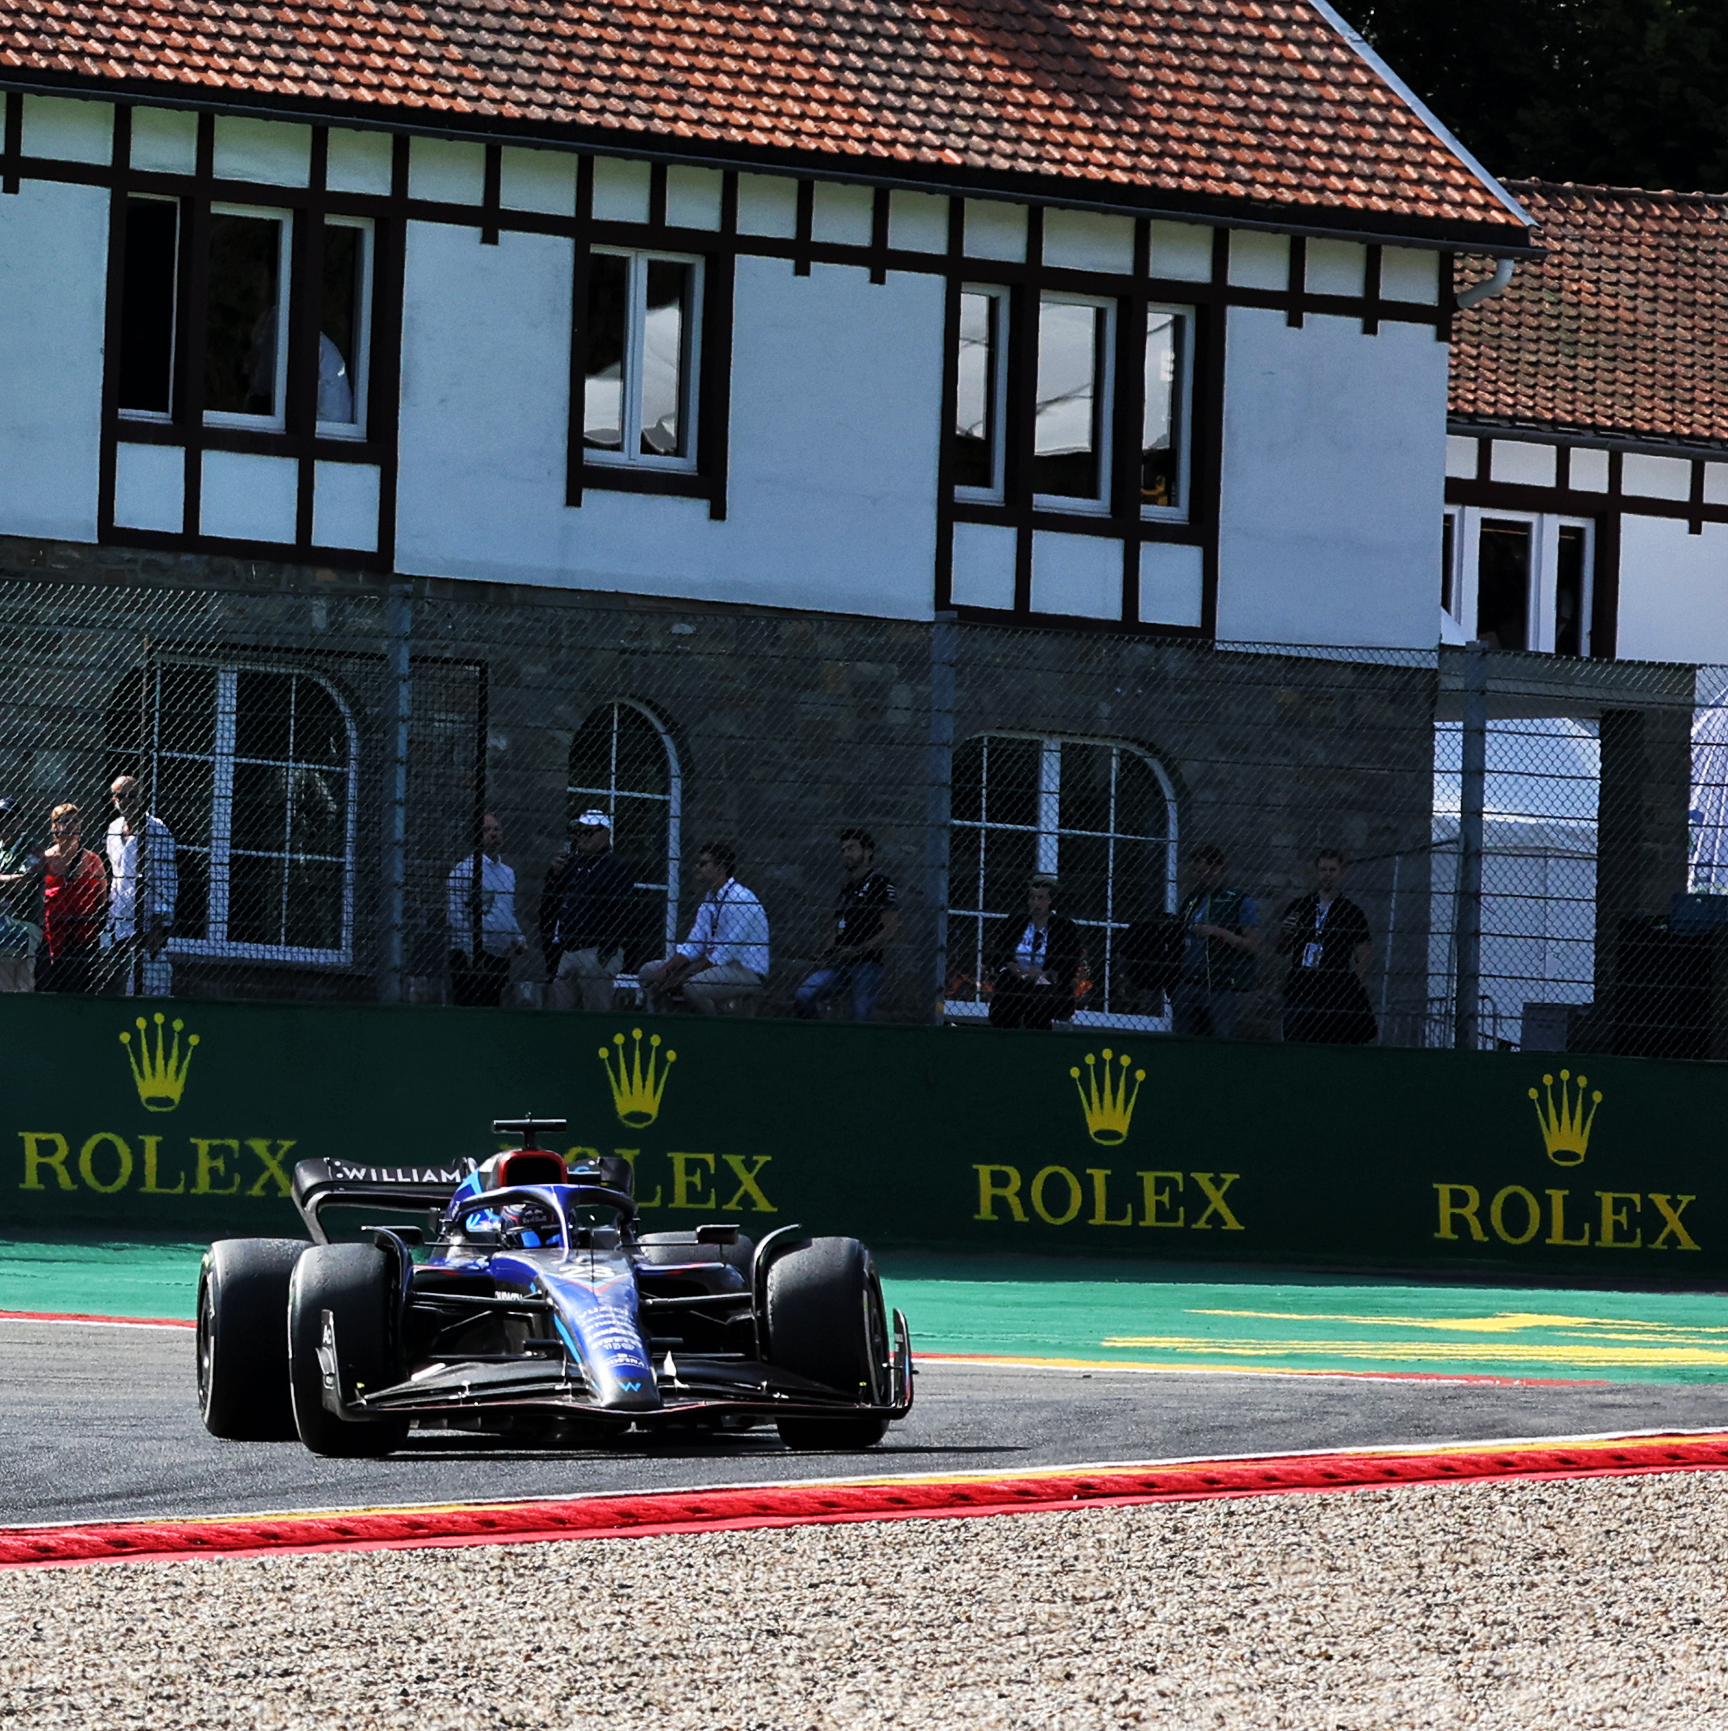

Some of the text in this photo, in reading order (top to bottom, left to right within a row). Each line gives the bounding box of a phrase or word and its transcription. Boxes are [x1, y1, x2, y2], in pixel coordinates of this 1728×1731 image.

[18, 1131, 297, 1198] ROLEX
[342, 1167, 464, 1183] WILLIAM
[499, 1143, 778, 1213] LEX
[972, 1164, 1245, 1230] ROLEX
[1433, 1183, 1702, 1251] ROLEX
